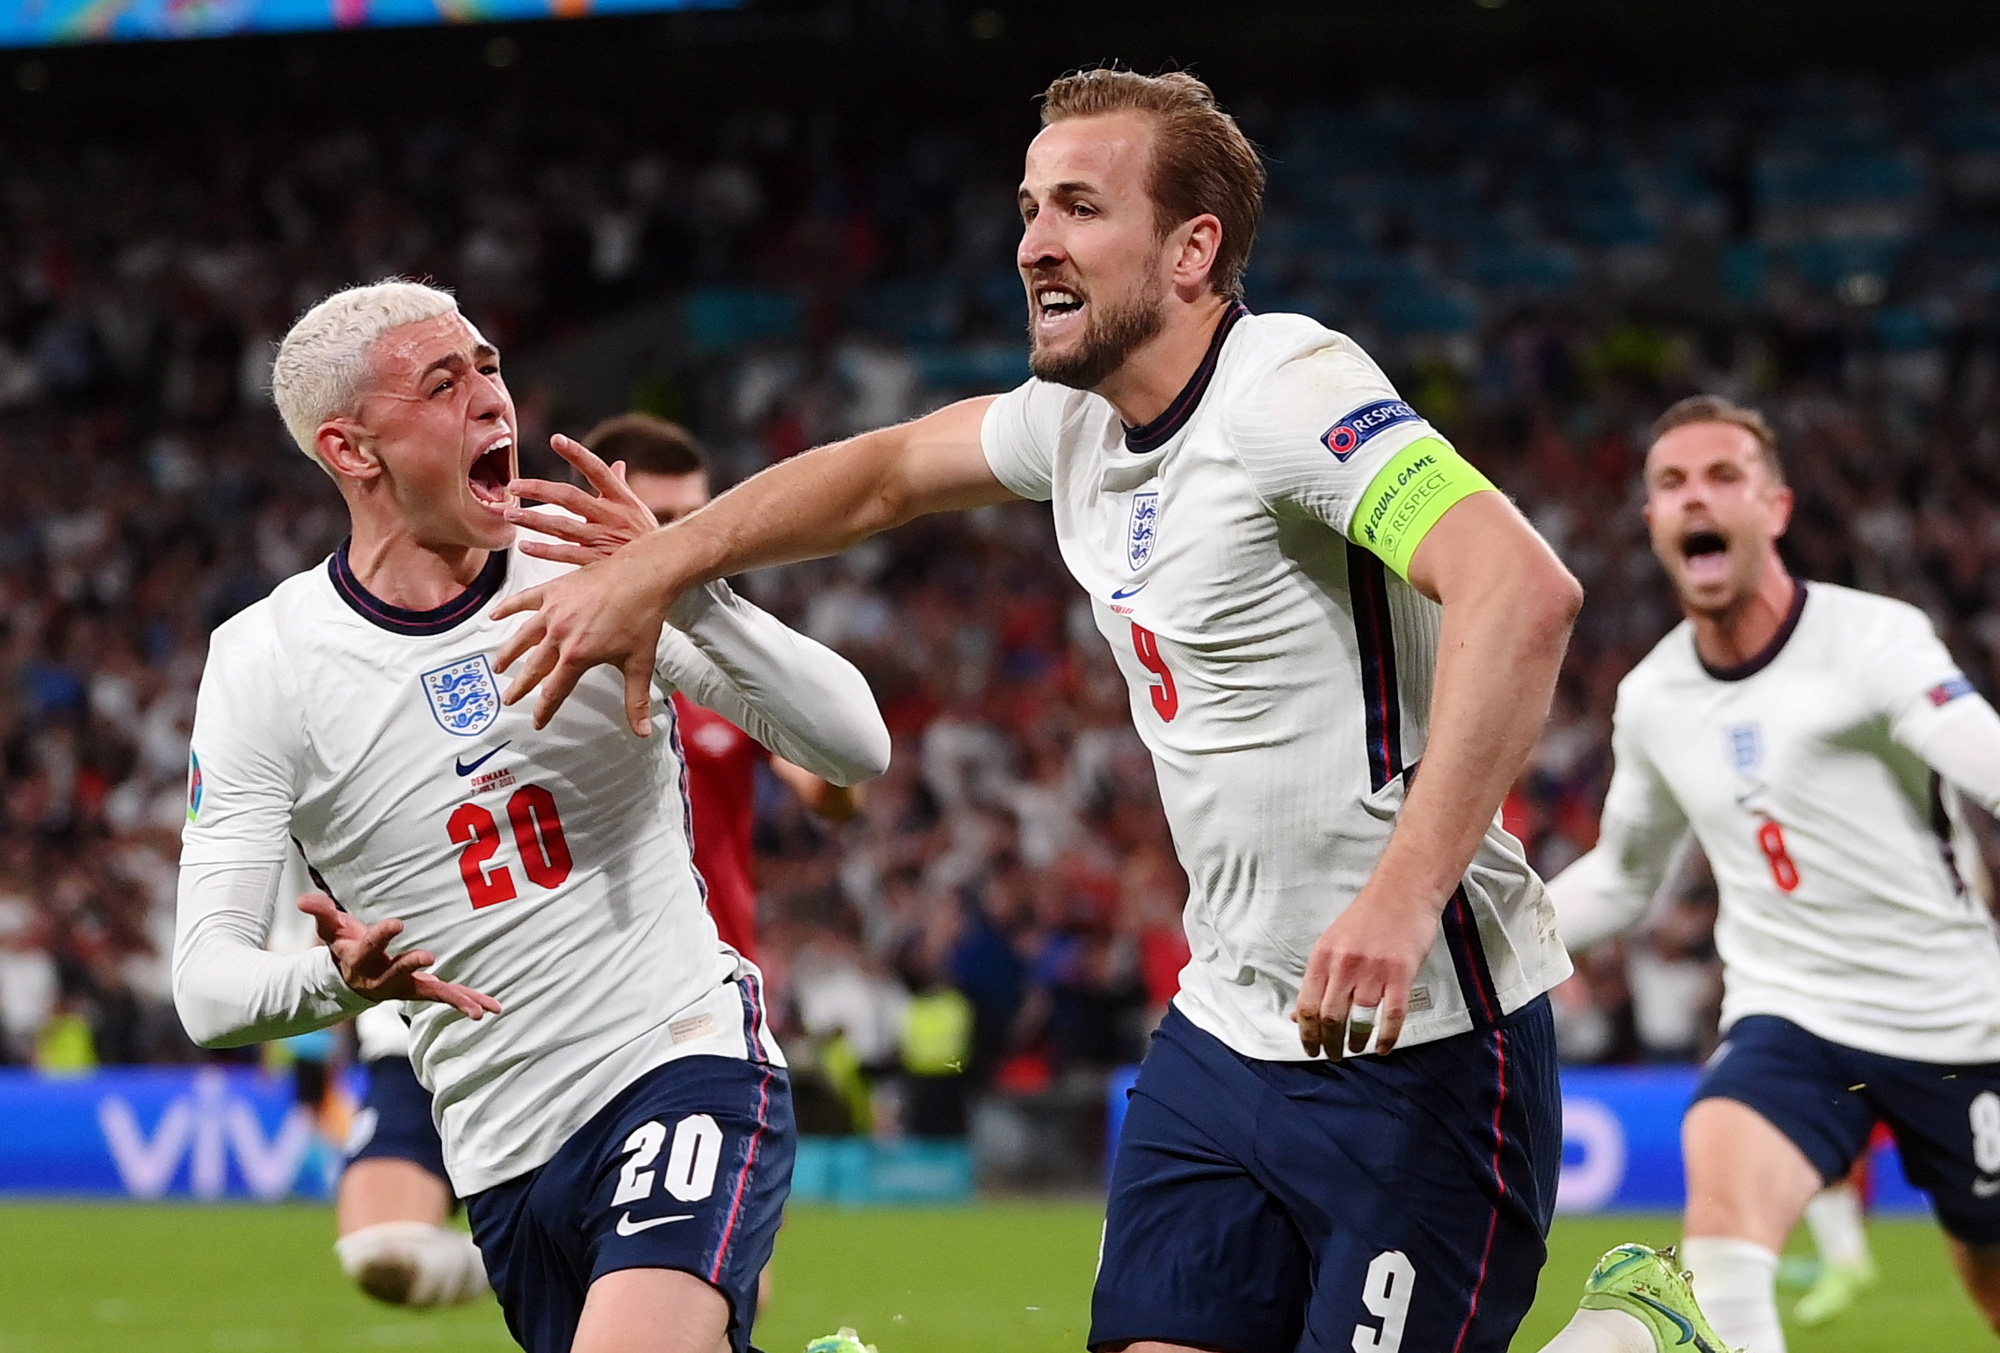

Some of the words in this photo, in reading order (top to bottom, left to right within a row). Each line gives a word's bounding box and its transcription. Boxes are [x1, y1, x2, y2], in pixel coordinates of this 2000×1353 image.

[1364, 485, 1399, 545] #EQUAL
[1397, 455, 1437, 486] GAME
[1392, 473, 1446, 532] RESPECT
[1131, 621, 1178, 723] 9
[471, 768, 509, 786] DENMARK
[446, 783, 574, 910] 20
[1759, 820, 1799, 891] 8
[98, 1064, 344, 1204] viv
[610, 1114, 724, 1207] 20
[1968, 1089, 2000, 1174] 8
[1351, 1250, 1416, 1353] 9
